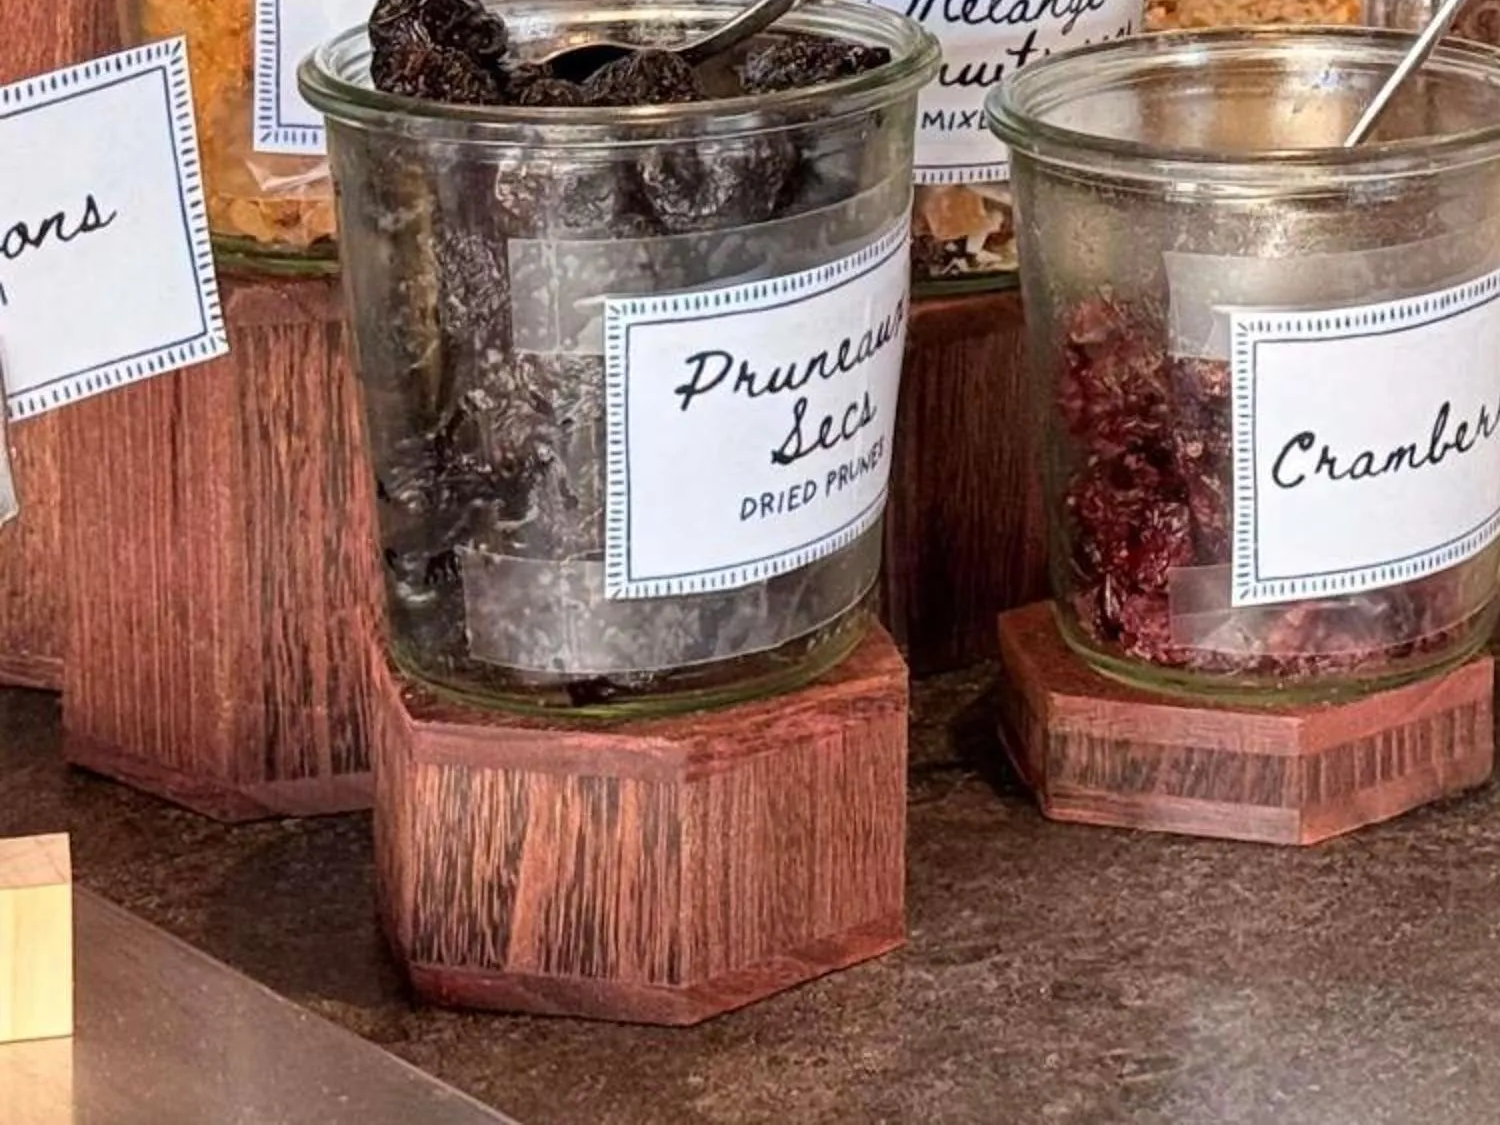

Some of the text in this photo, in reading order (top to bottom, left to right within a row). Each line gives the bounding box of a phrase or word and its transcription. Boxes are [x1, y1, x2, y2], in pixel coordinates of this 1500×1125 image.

[0, 193, 118, 261] ons
[771, 391, 878, 466] Secs
[739, 435, 886, 522] DRIED PRUNES
